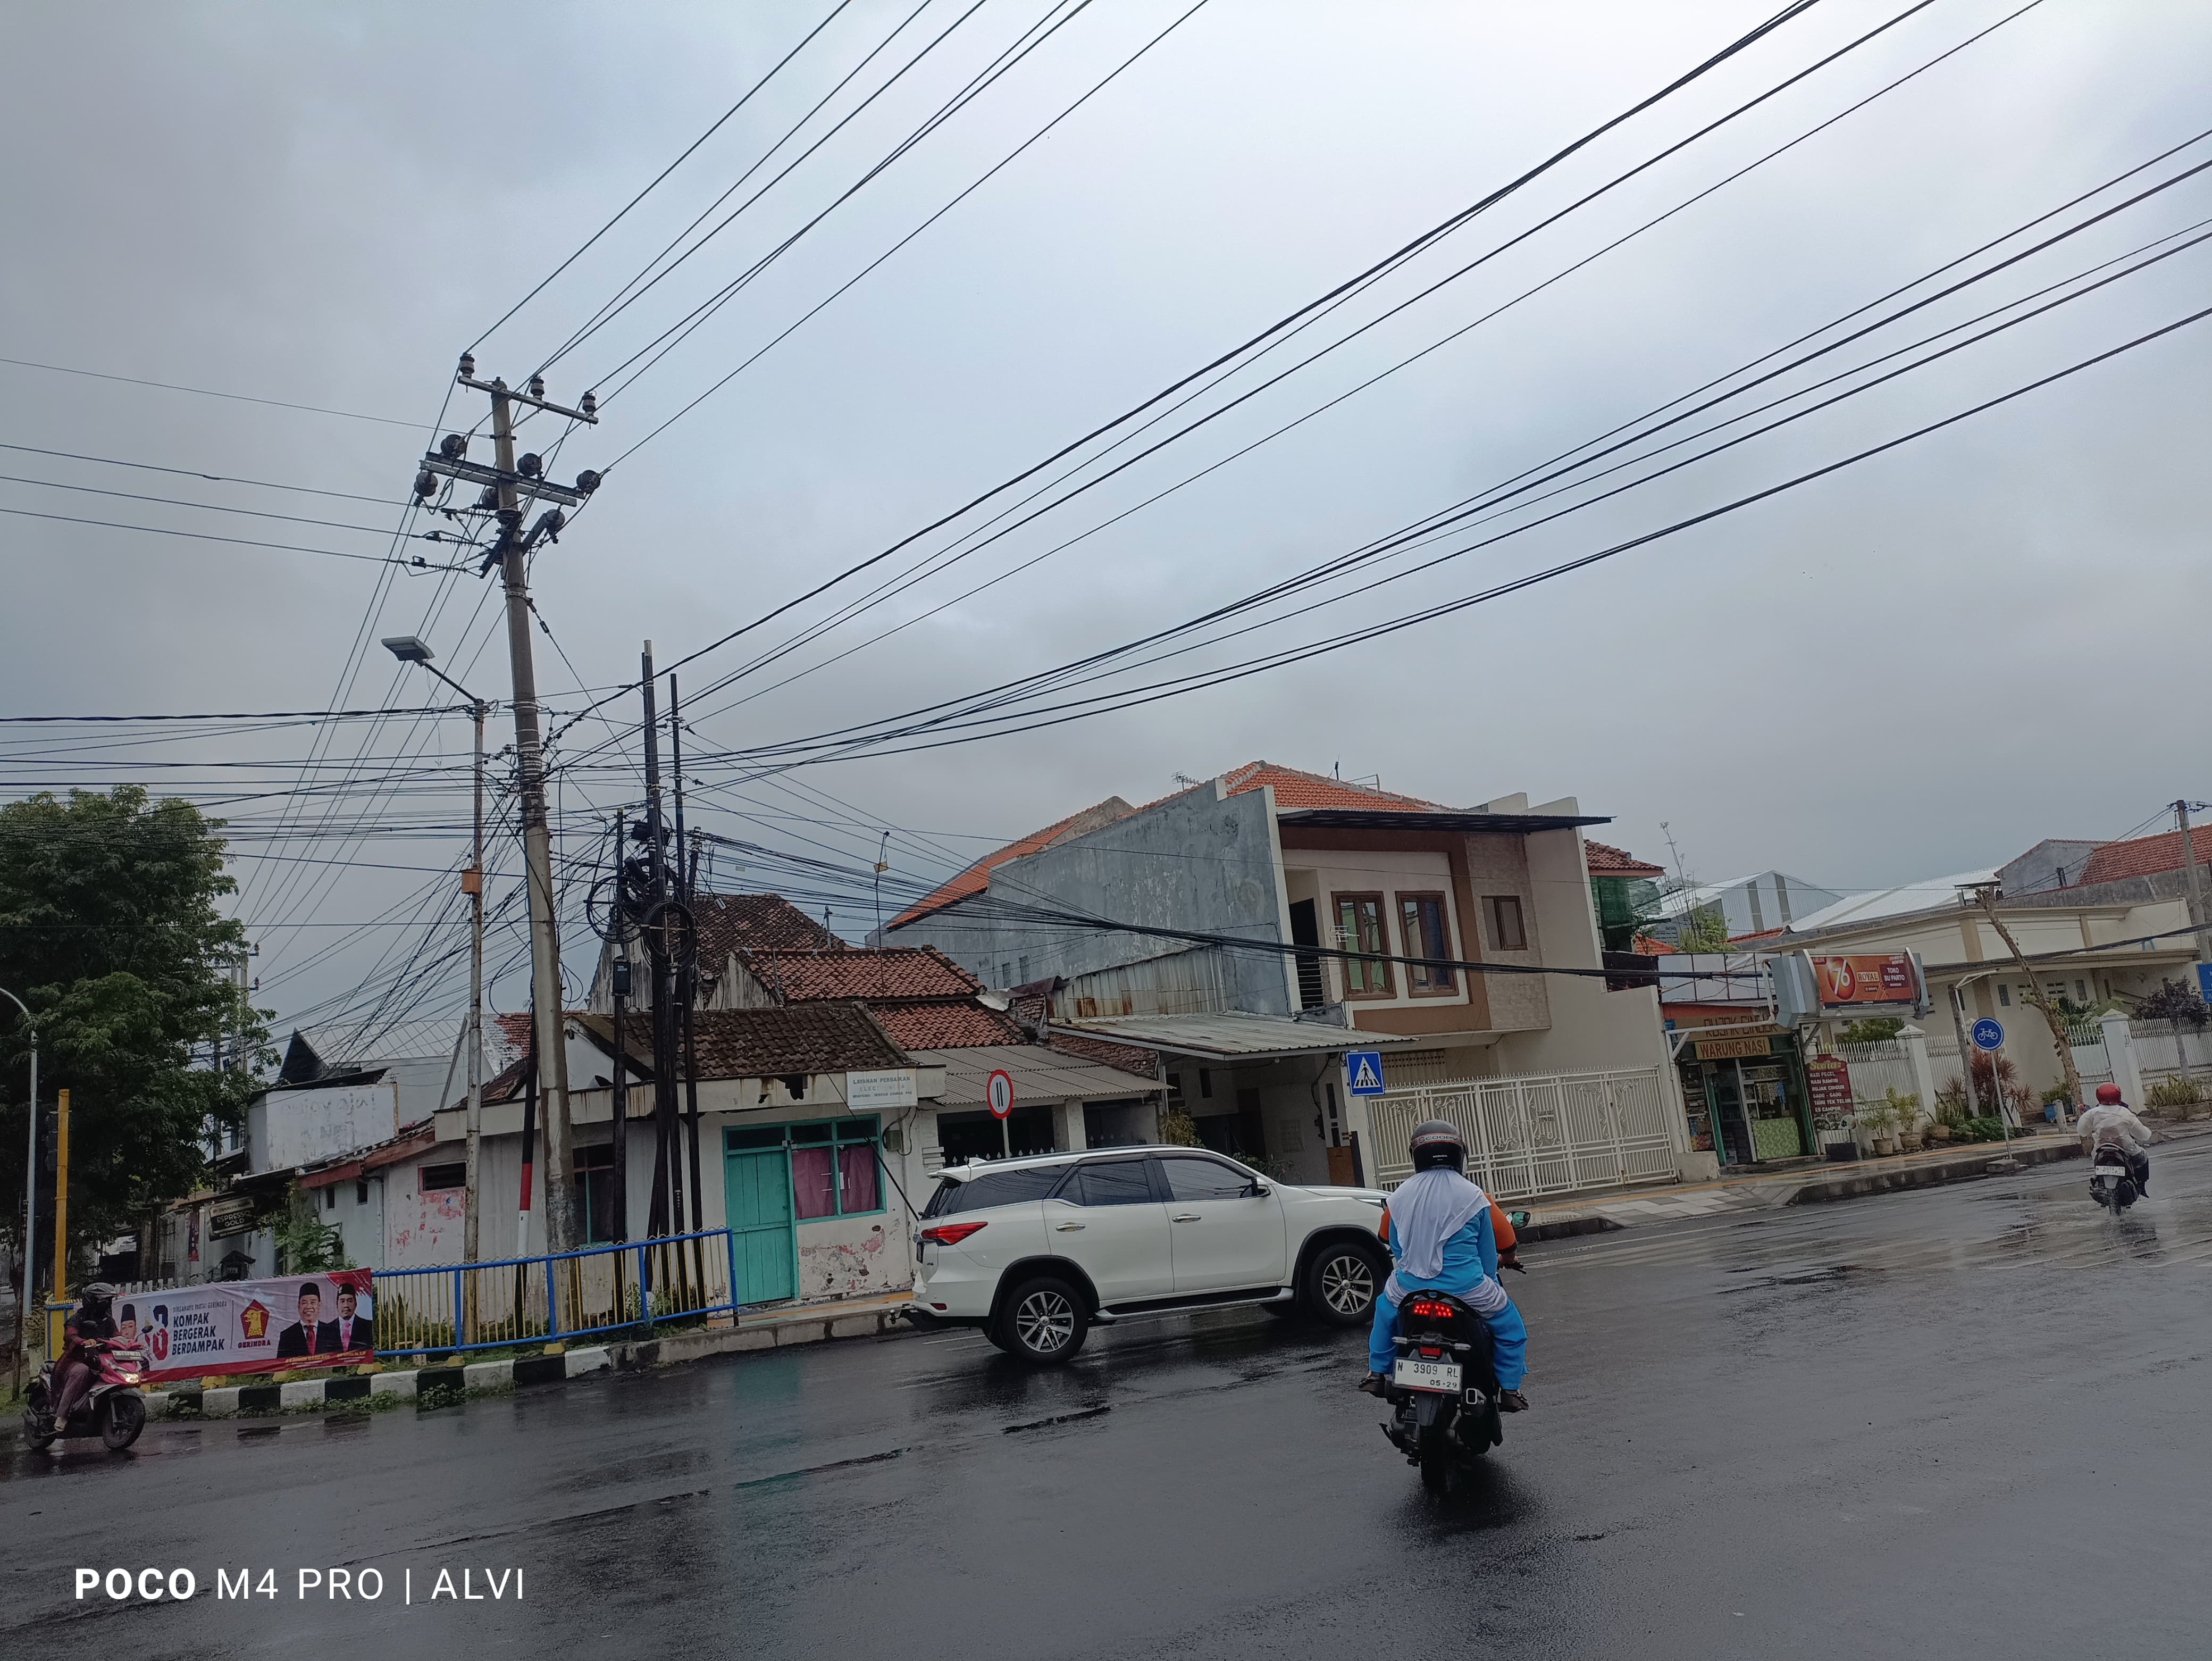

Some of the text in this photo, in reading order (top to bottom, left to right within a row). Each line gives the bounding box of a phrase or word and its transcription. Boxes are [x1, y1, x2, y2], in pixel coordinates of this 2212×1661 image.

[1832, 959, 1850, 995] 76
[1703, 1016, 1739, 1037] RUJAK
[1699, 1039, 1767, 1058] WARUNG NASI
[216, 1210, 250, 1223] ESPRESSO
[224, 1218, 245, 1227] GOLD
[207, 1300, 227, 1309] GERINDRA
[173, 1312, 210, 1328] KOMPAK
[173, 1325, 216, 1341] BERGERAK
[172, 1339, 225, 1356] BERDAMPAK
[238, 1339, 271, 1348] GERINDRA
[1397, 1362, 1459, 1378] N 3909 RL
